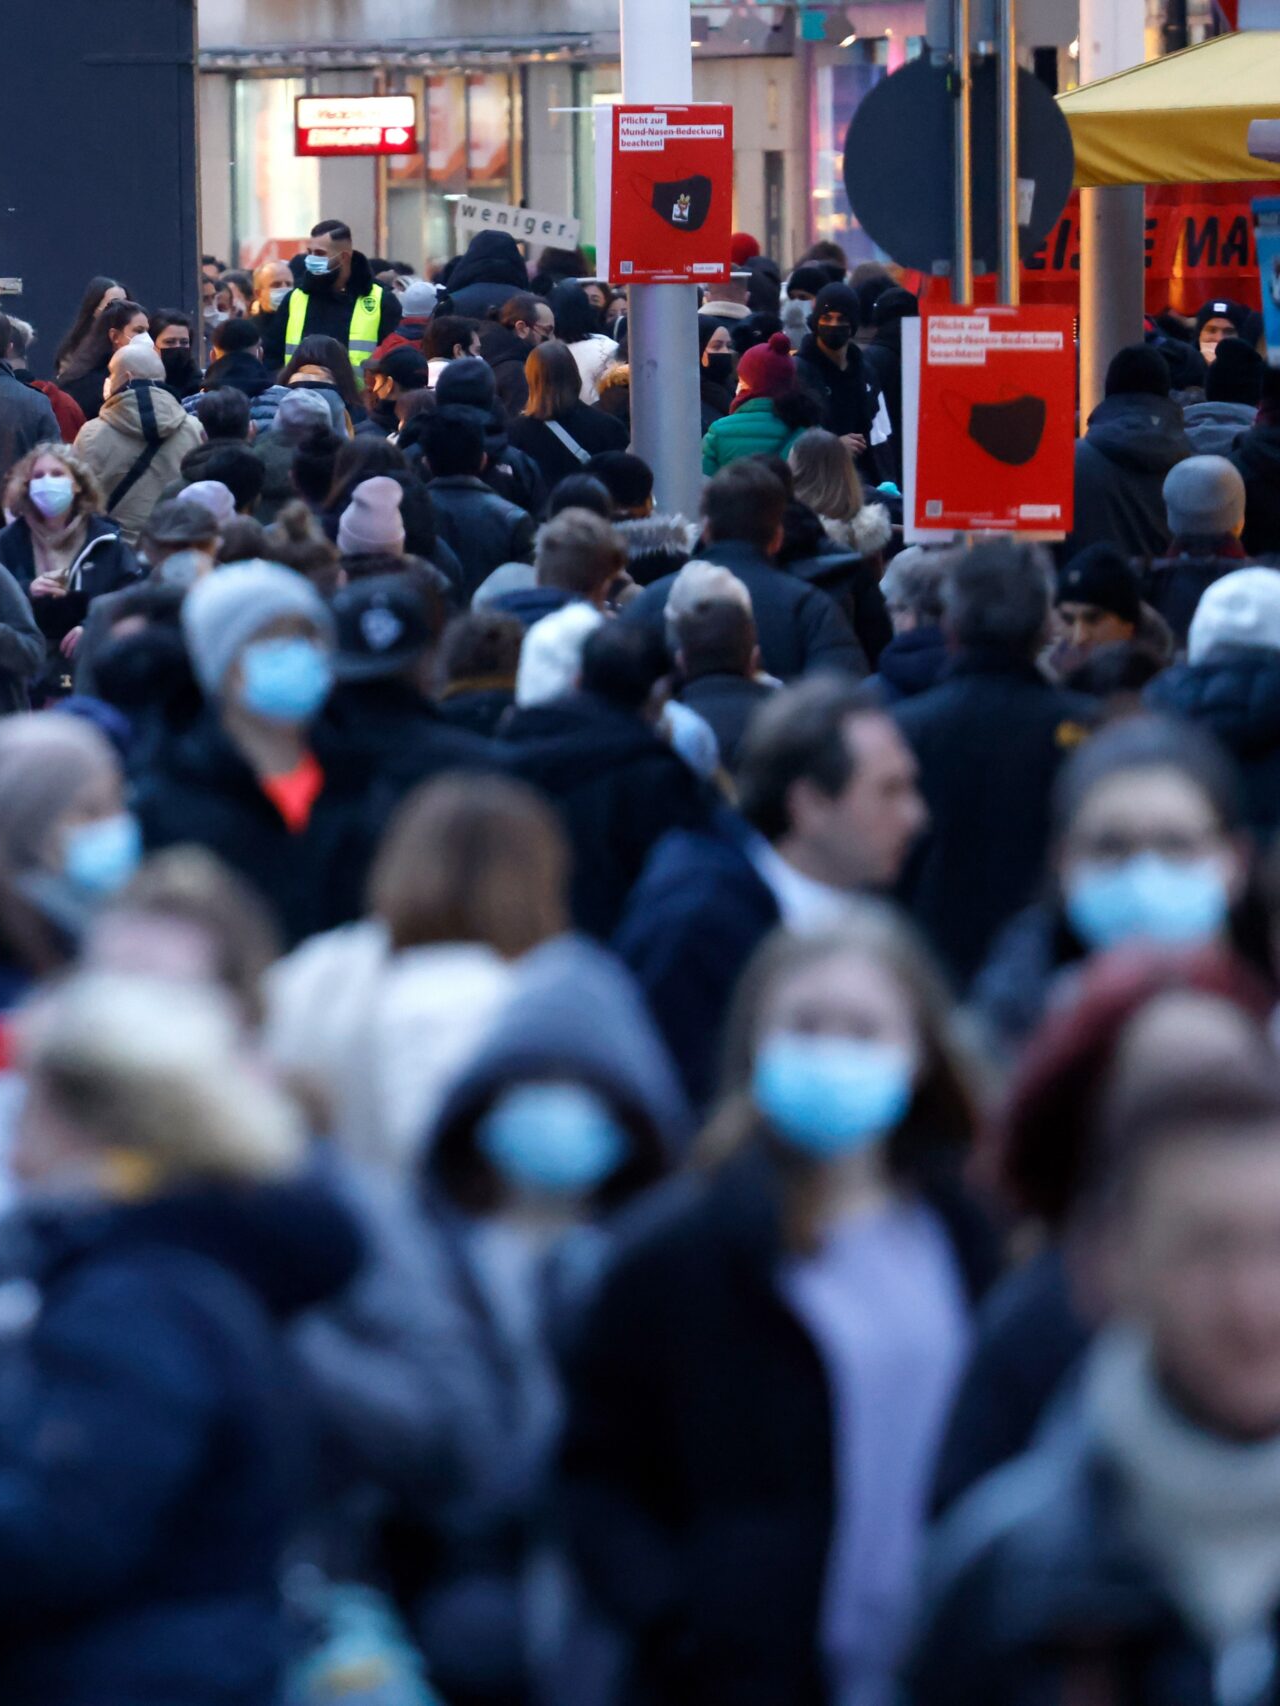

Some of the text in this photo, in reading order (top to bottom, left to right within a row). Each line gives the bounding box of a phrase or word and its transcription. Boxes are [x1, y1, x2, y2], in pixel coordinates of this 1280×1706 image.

[621, 116, 648, 124] Pflicht
[621, 127, 722, 136] Mund-Nasen-Bedeckung
[621, 139, 663, 147] beachten!
[1185, 215, 1259, 268] MA
